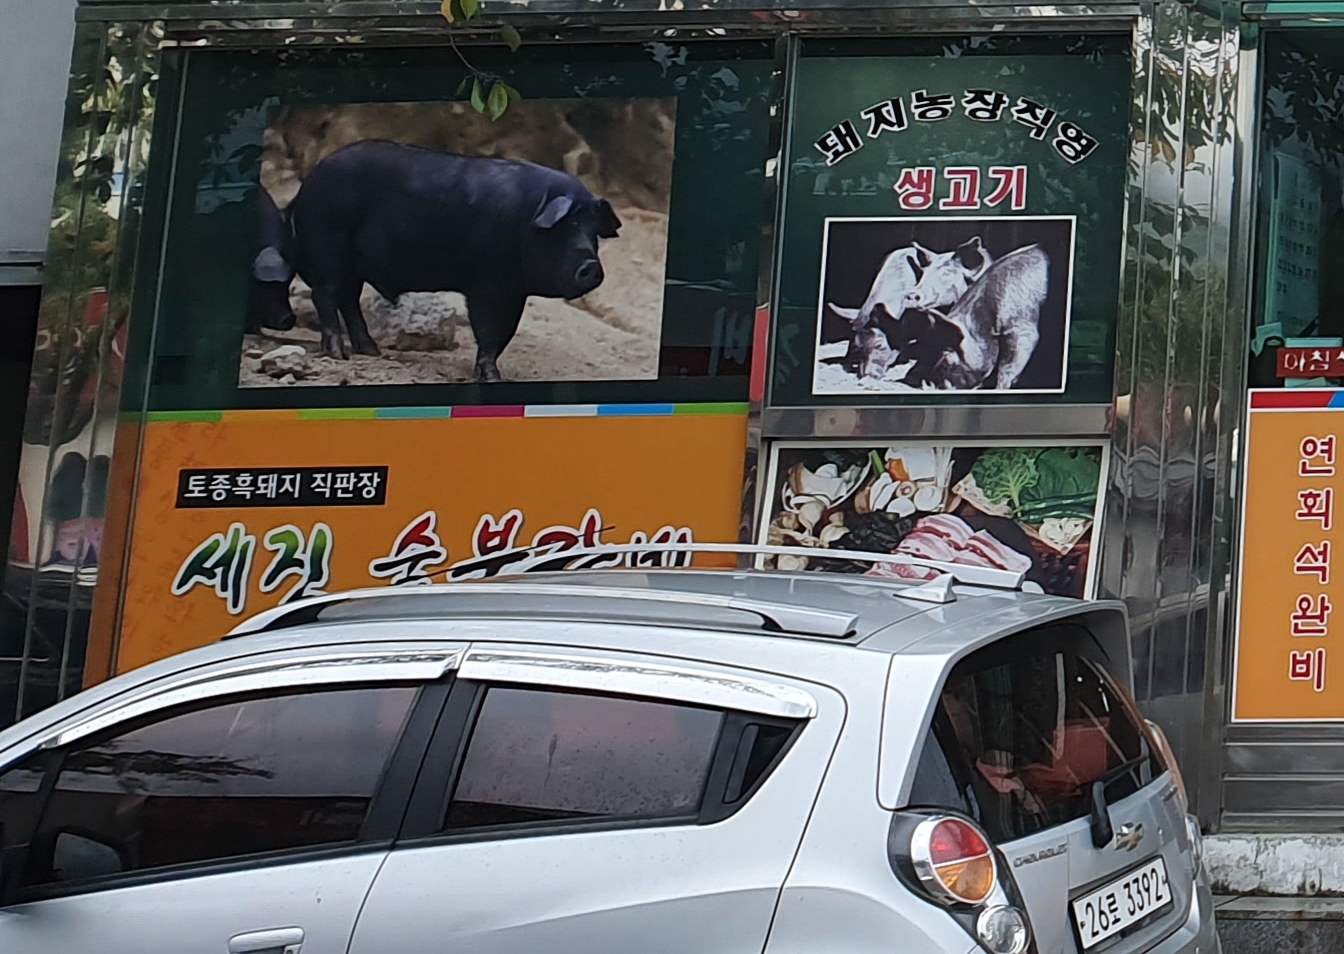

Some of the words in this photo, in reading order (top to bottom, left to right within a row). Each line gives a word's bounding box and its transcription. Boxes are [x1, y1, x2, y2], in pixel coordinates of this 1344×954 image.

[814, 88, 1100, 166] 돼지농장직영
[894, 165, 1028, 211] 생고기
[184, 473, 301, 501] 토종흑돼지
[310, 471, 381, 499] 직판장
[1289, 435, 1336, 691] 연회석완비
[1085, 892, 1122, 938] 26로
[1123, 867, 1163, 917] 3392
